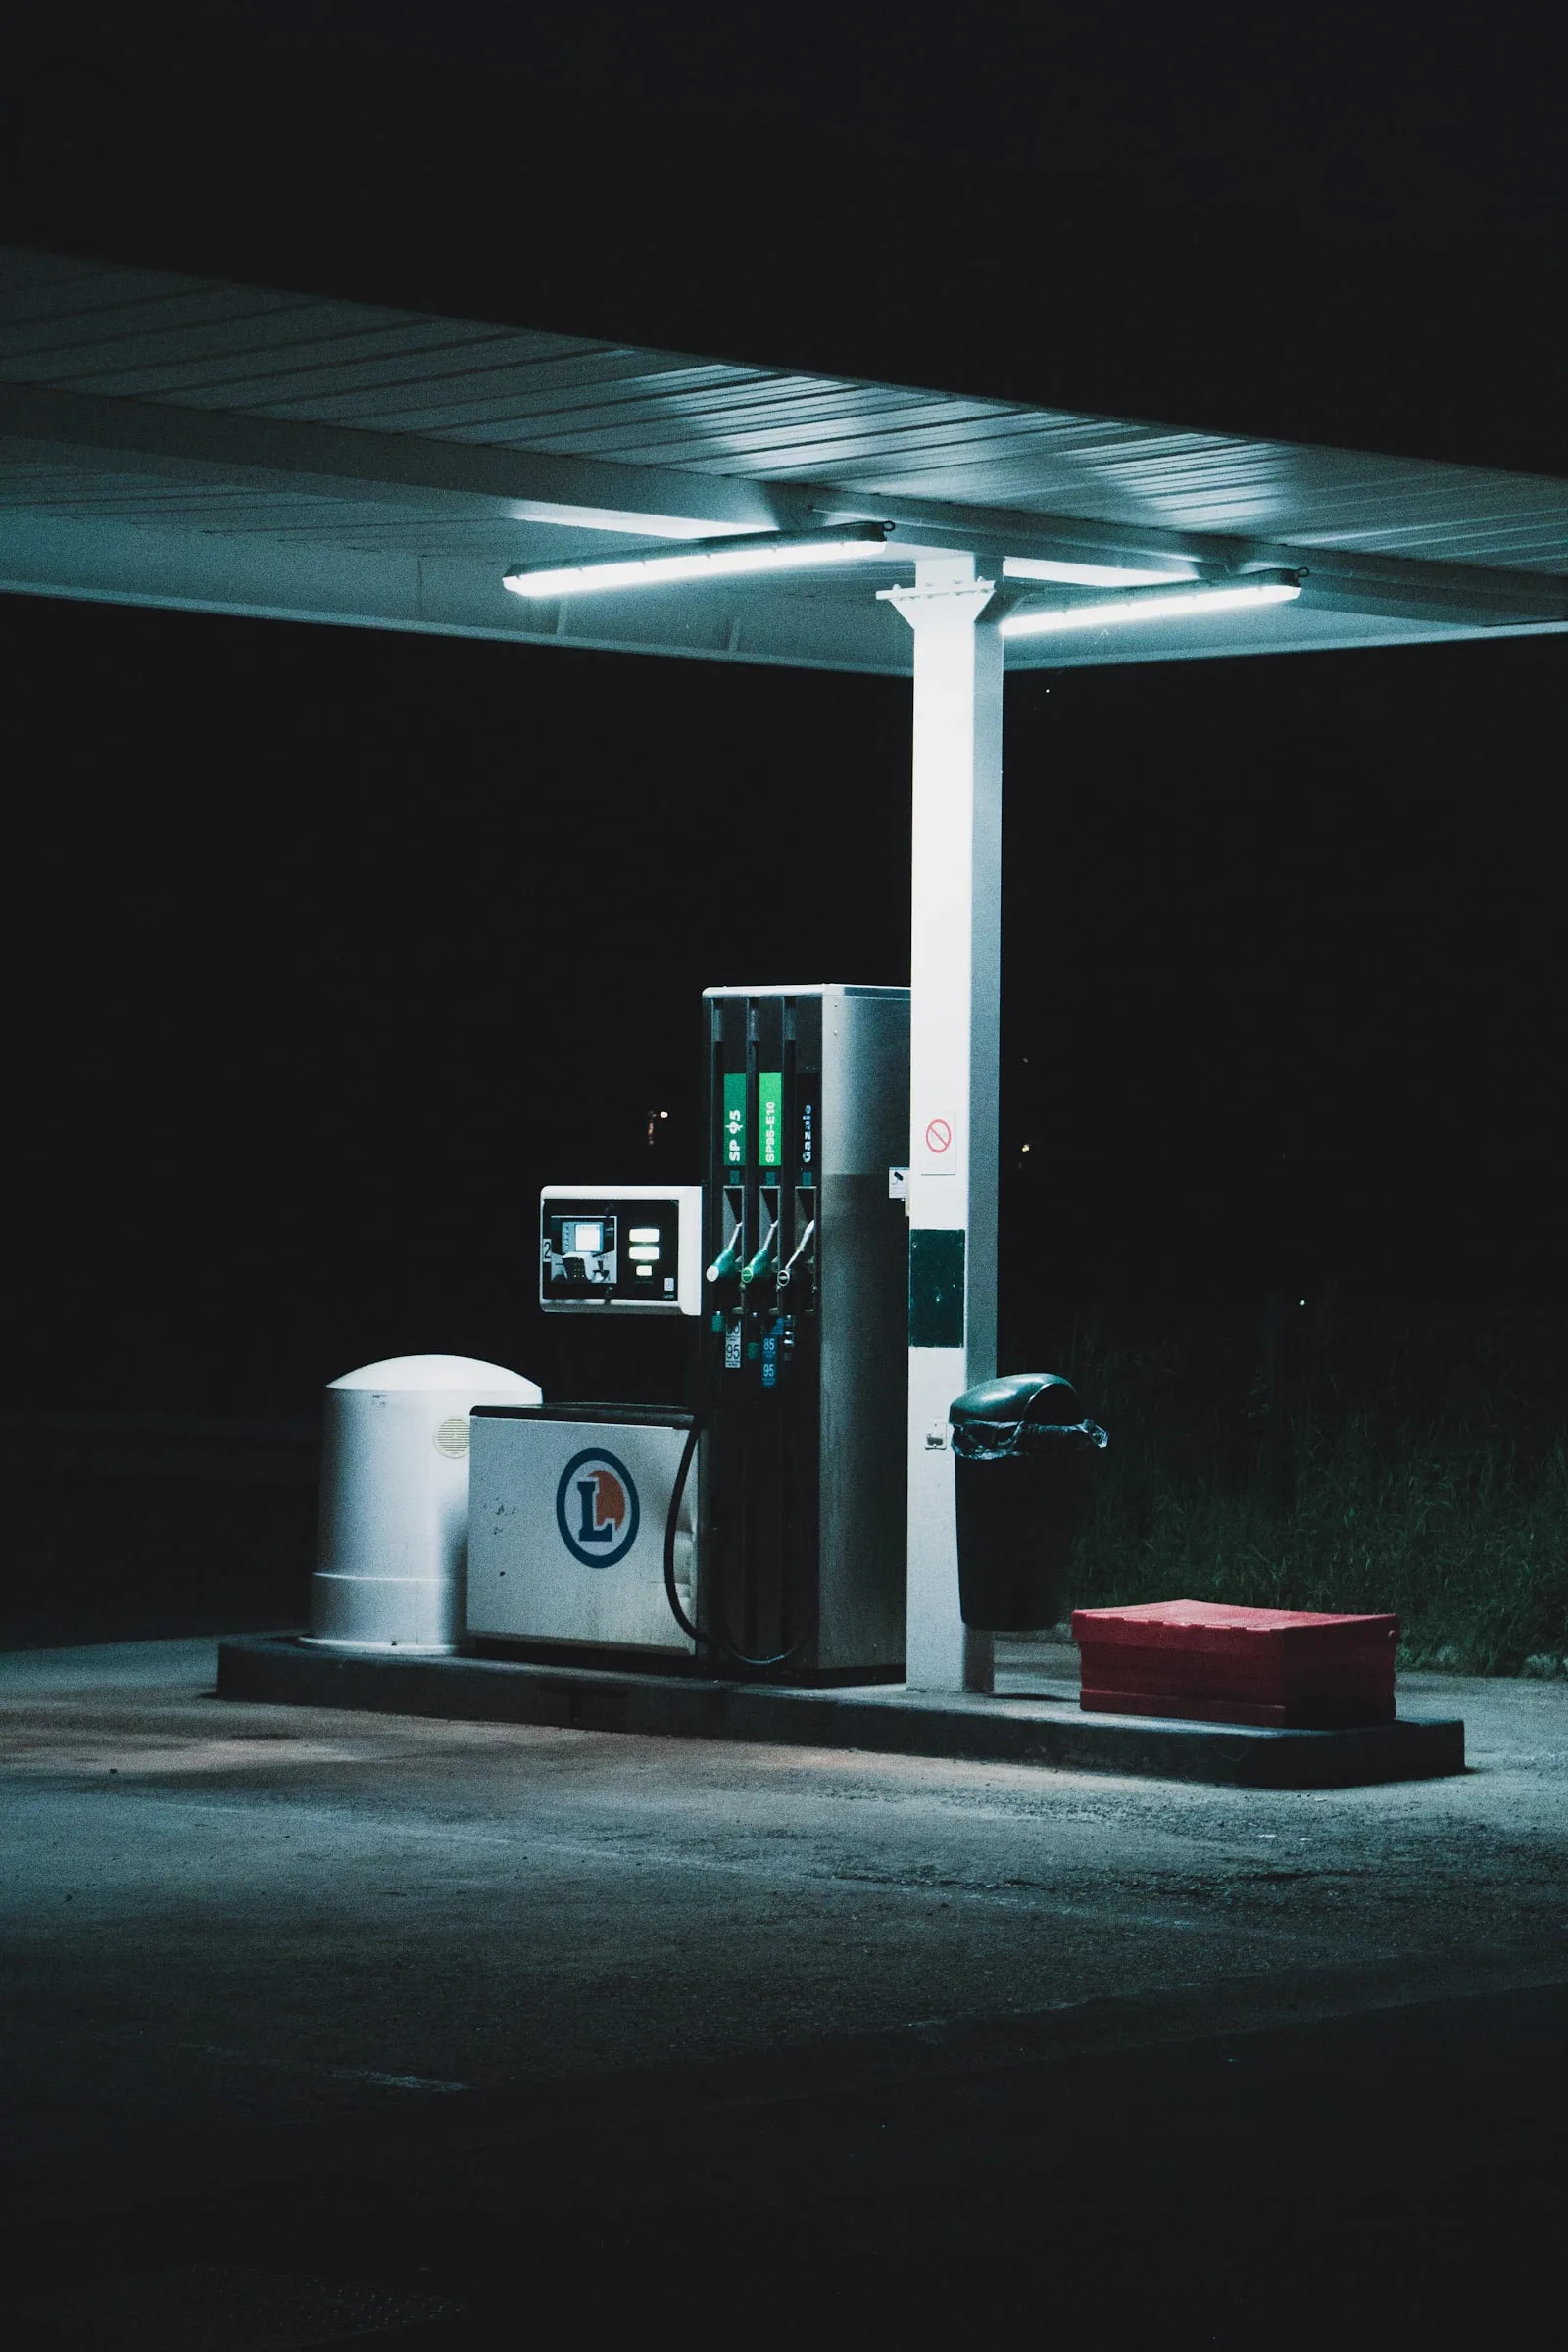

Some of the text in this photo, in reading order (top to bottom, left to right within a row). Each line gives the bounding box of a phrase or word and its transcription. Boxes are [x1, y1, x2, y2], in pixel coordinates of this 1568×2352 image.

[765, 1101, 775, 1163] SP95-E10
[728, 1139, 741, 1161] SP
[542, 1241, 551, 1259] 2
[726, 1343, 740, 1360] 95
[576, 1481, 612, 1542] L
